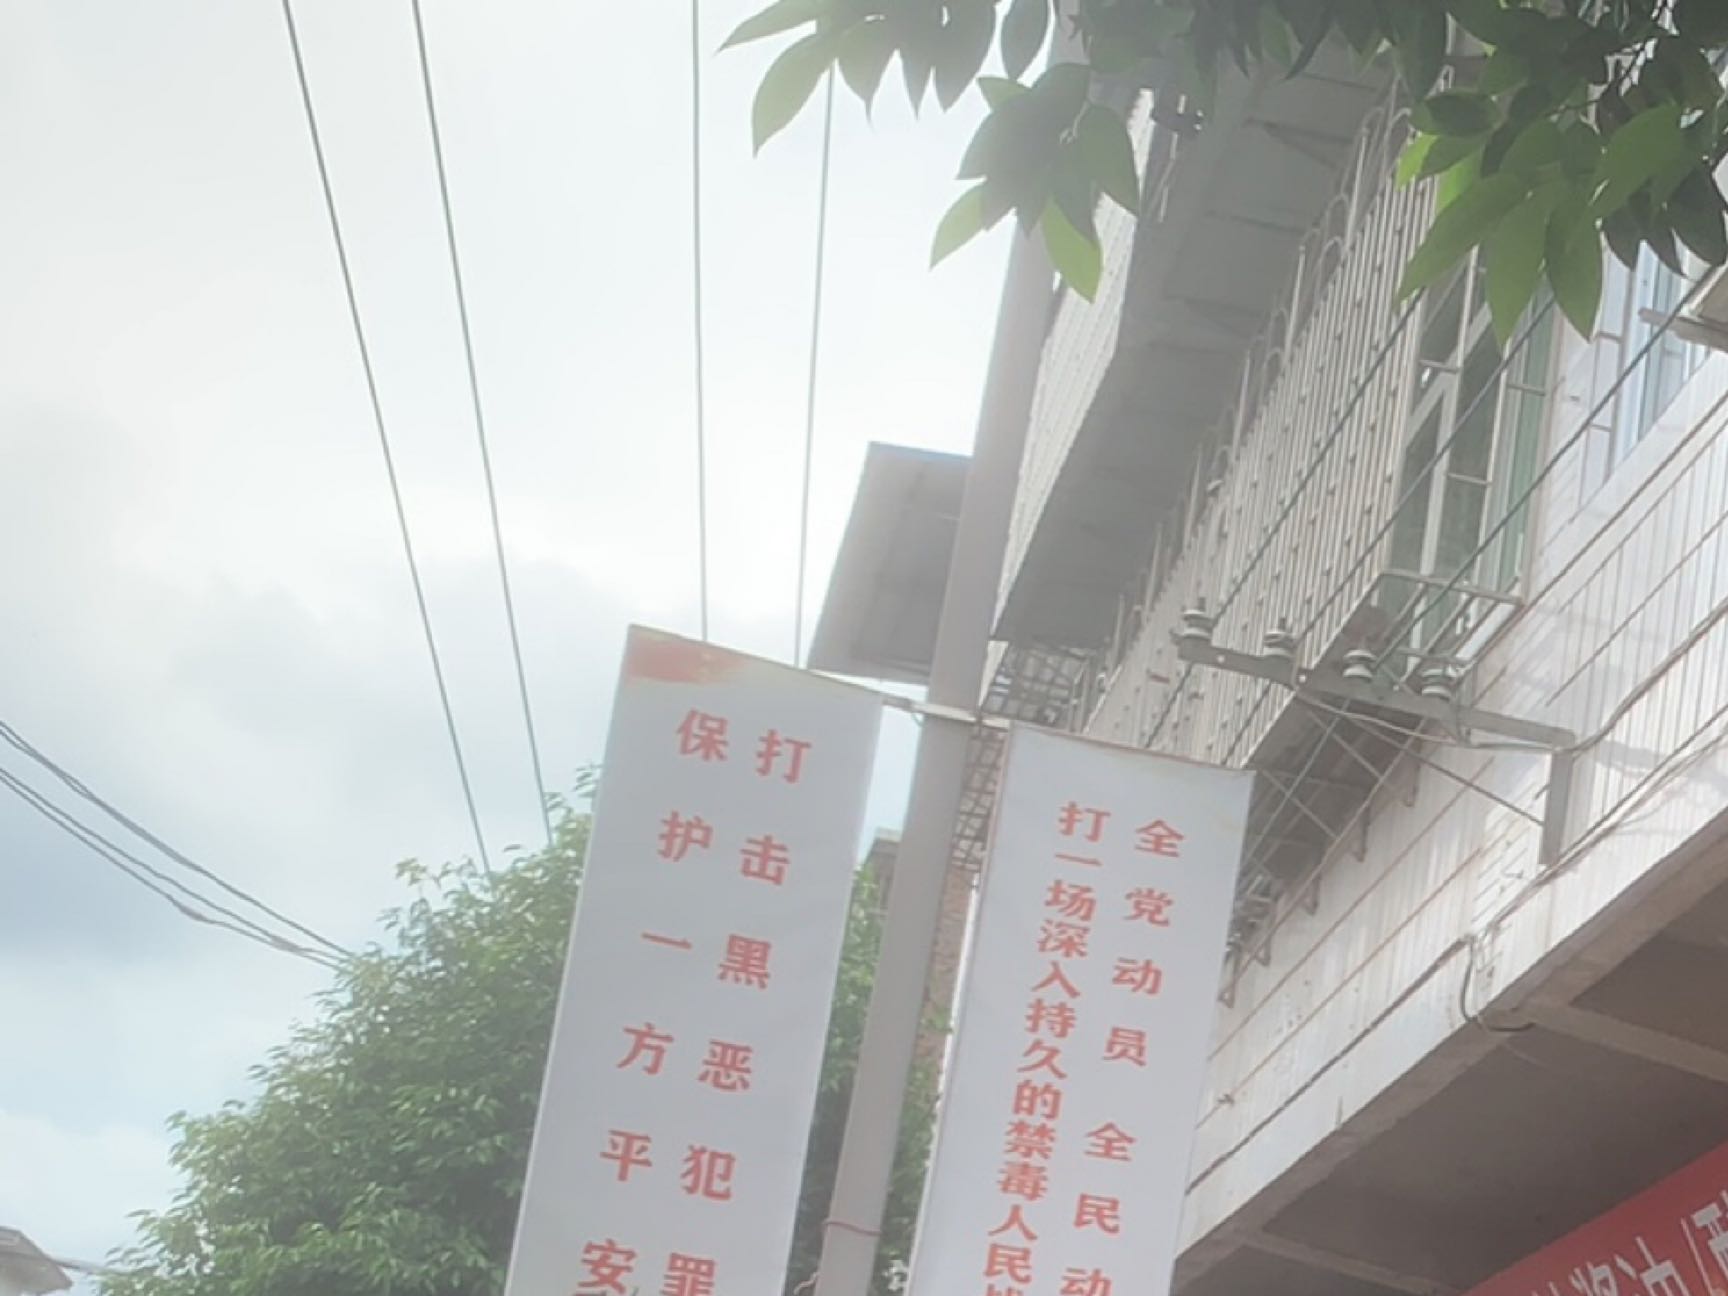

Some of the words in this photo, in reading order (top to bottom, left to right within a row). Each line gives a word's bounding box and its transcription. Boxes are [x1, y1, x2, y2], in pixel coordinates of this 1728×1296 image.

[577, 708, 731, 1296] 保护一方平安
